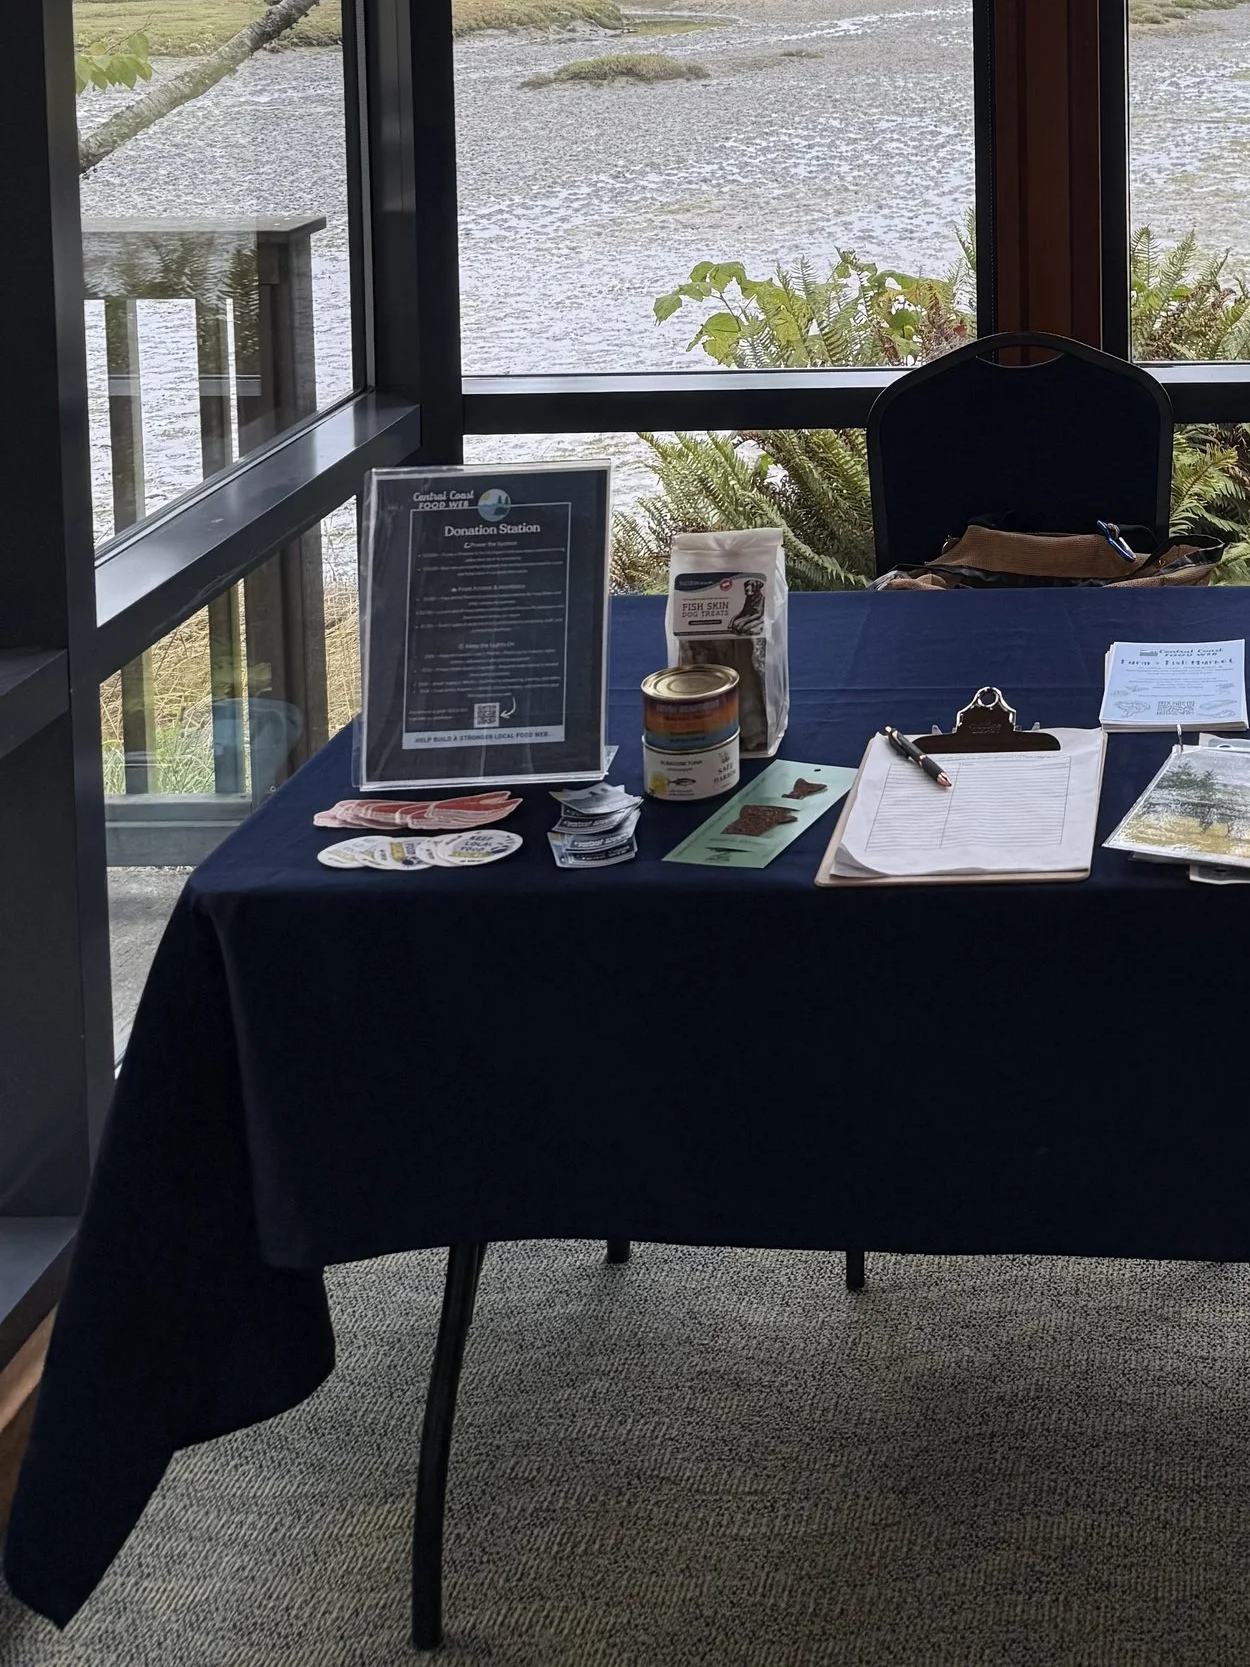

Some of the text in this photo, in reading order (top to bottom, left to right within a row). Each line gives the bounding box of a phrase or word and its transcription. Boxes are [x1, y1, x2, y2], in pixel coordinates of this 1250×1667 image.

[413, 490, 474, 502] Central Coast
[444, 523, 541, 537] Donation Station
[682, 601, 729, 612] FISH SKIN
